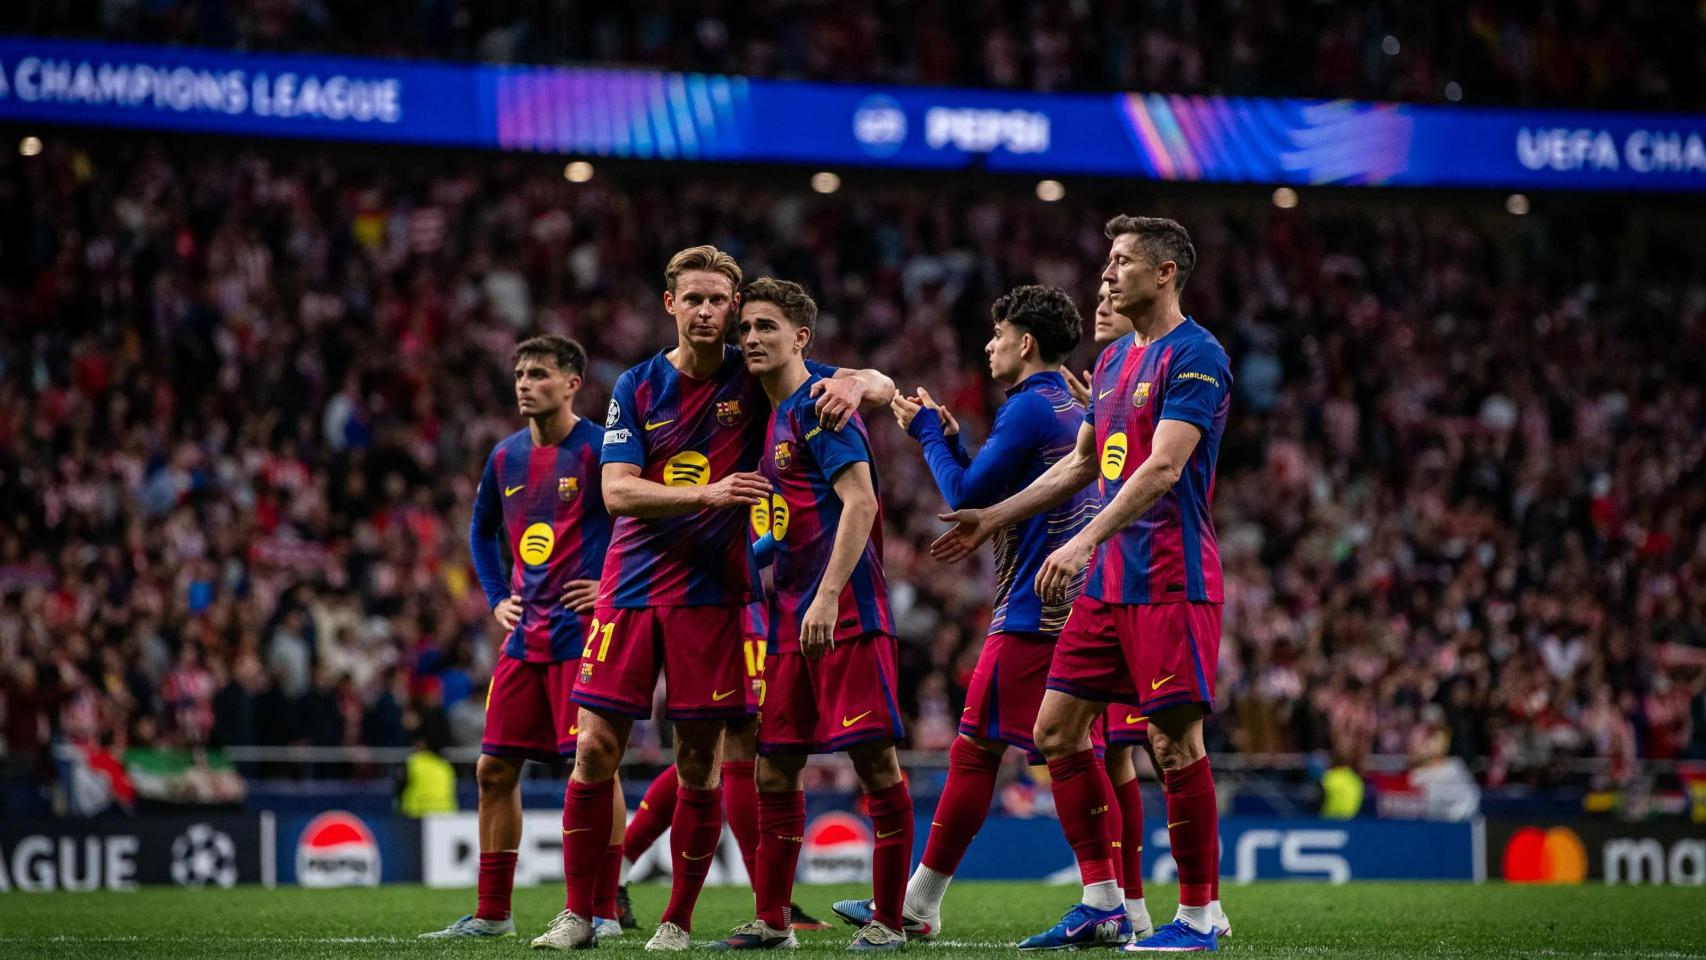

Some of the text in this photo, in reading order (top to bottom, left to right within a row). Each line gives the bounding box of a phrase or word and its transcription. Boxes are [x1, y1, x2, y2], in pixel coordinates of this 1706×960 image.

[14, 56, 248, 114] CHAMPIONS
[252, 72, 402, 123] LEAGUE
[925, 106, 1050, 154] PEPSI
[1516, 126, 1620, 172] UEFA
[582, 617, 616, 662] 21
